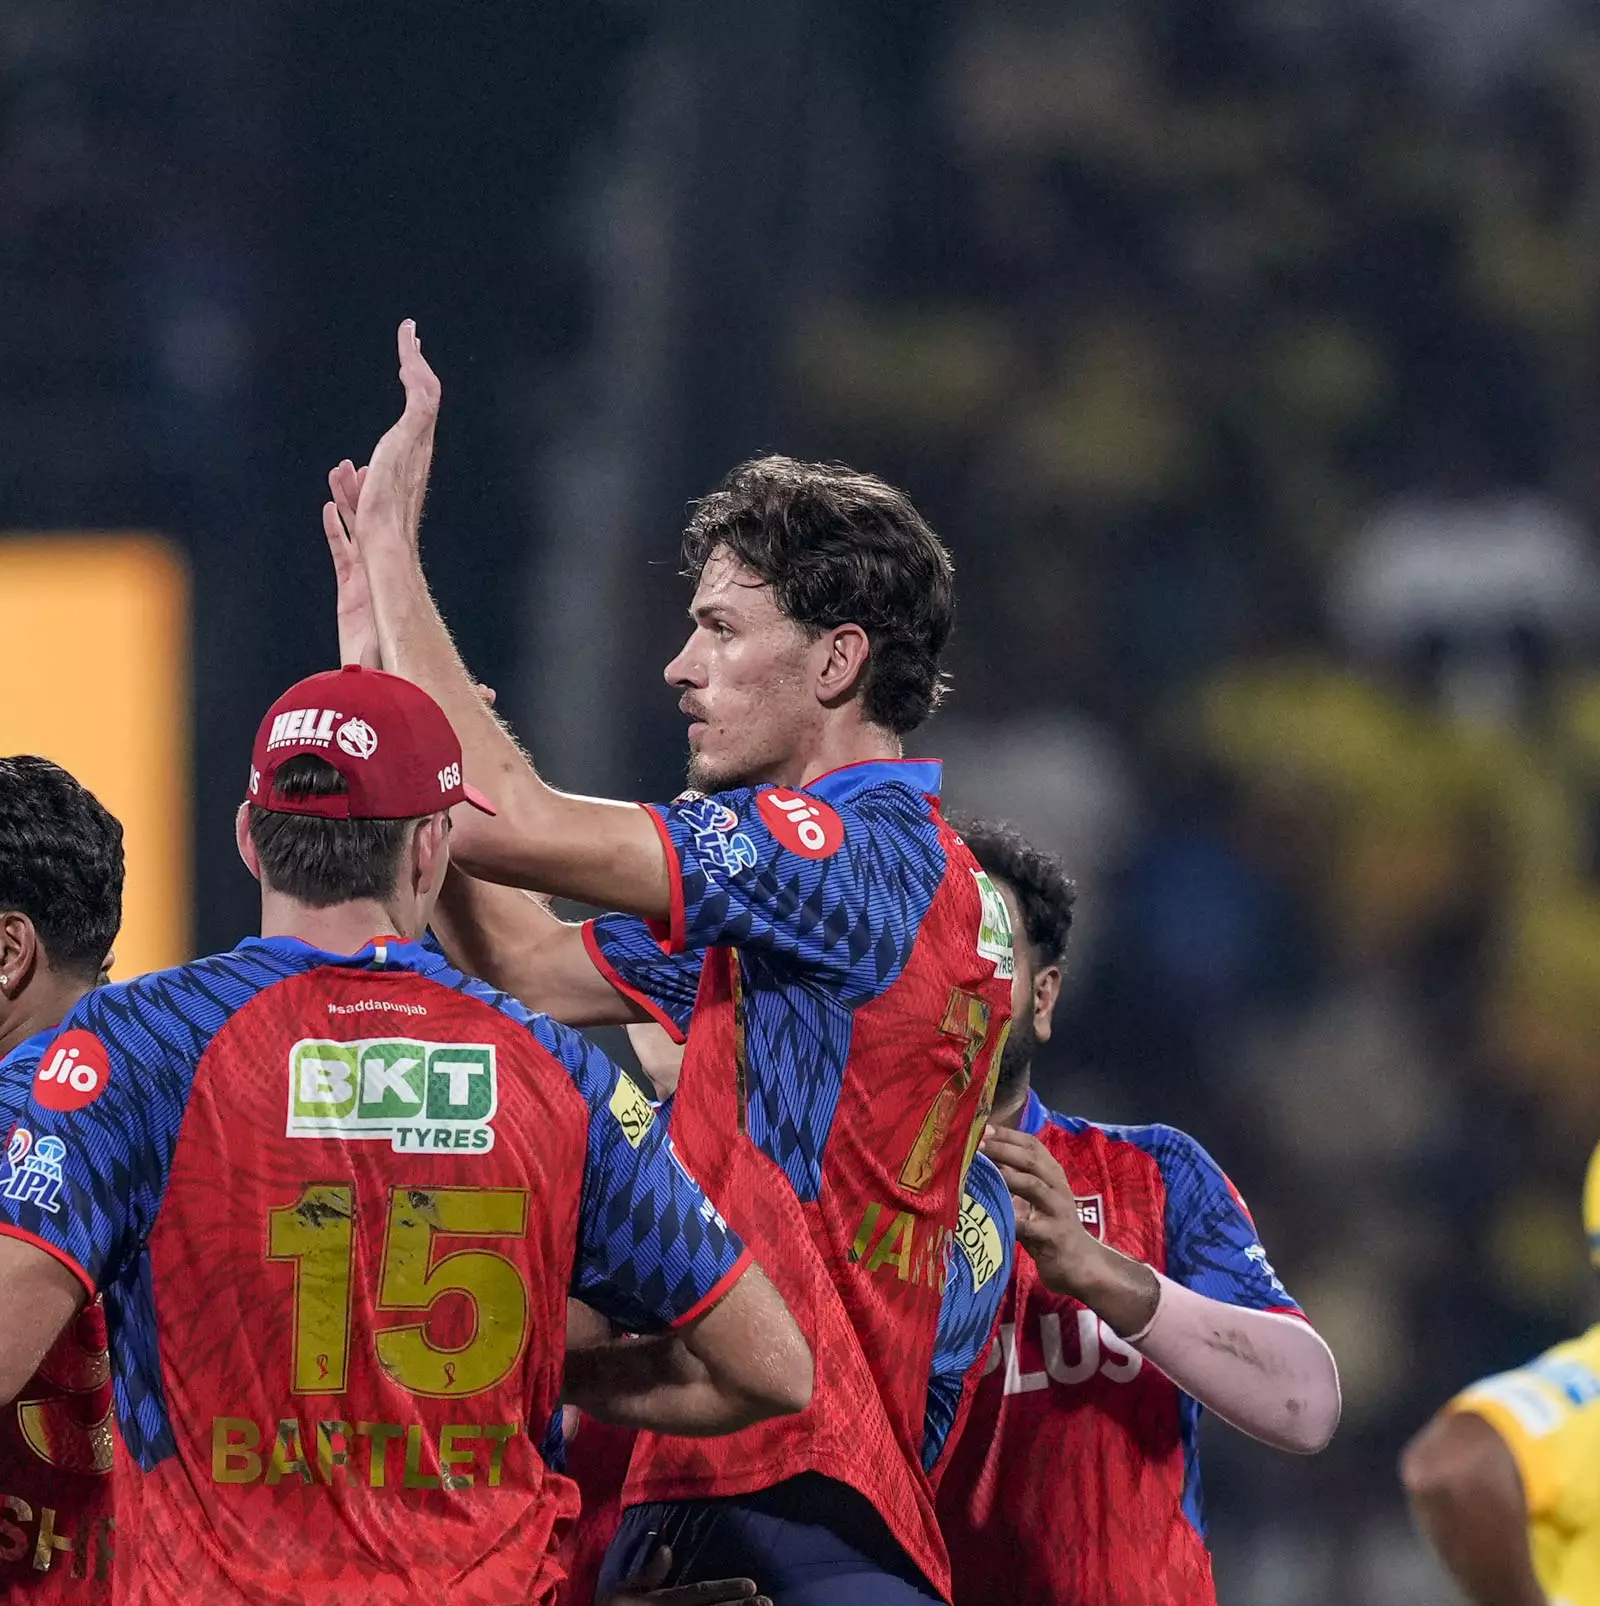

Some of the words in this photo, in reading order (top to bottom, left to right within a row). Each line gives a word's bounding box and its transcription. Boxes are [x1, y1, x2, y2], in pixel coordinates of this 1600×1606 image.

[268, 709, 336, 745] HELL
[438, 762, 460, 793] 168
[768, 794, 825, 850] Jio
[328, 999, 427, 1016] #saddapunjab
[38, 1048, 98, 1092] Jio
[299, 1057, 484, 1105] BKT
[397, 1127, 489, 1148] TYRES
[26, 1158, 60, 1178] TATA
[5, 1172, 61, 1212] IPL
[265, 1181, 532, 1398] 15
[984, 1309, 1143, 1396] LUS
